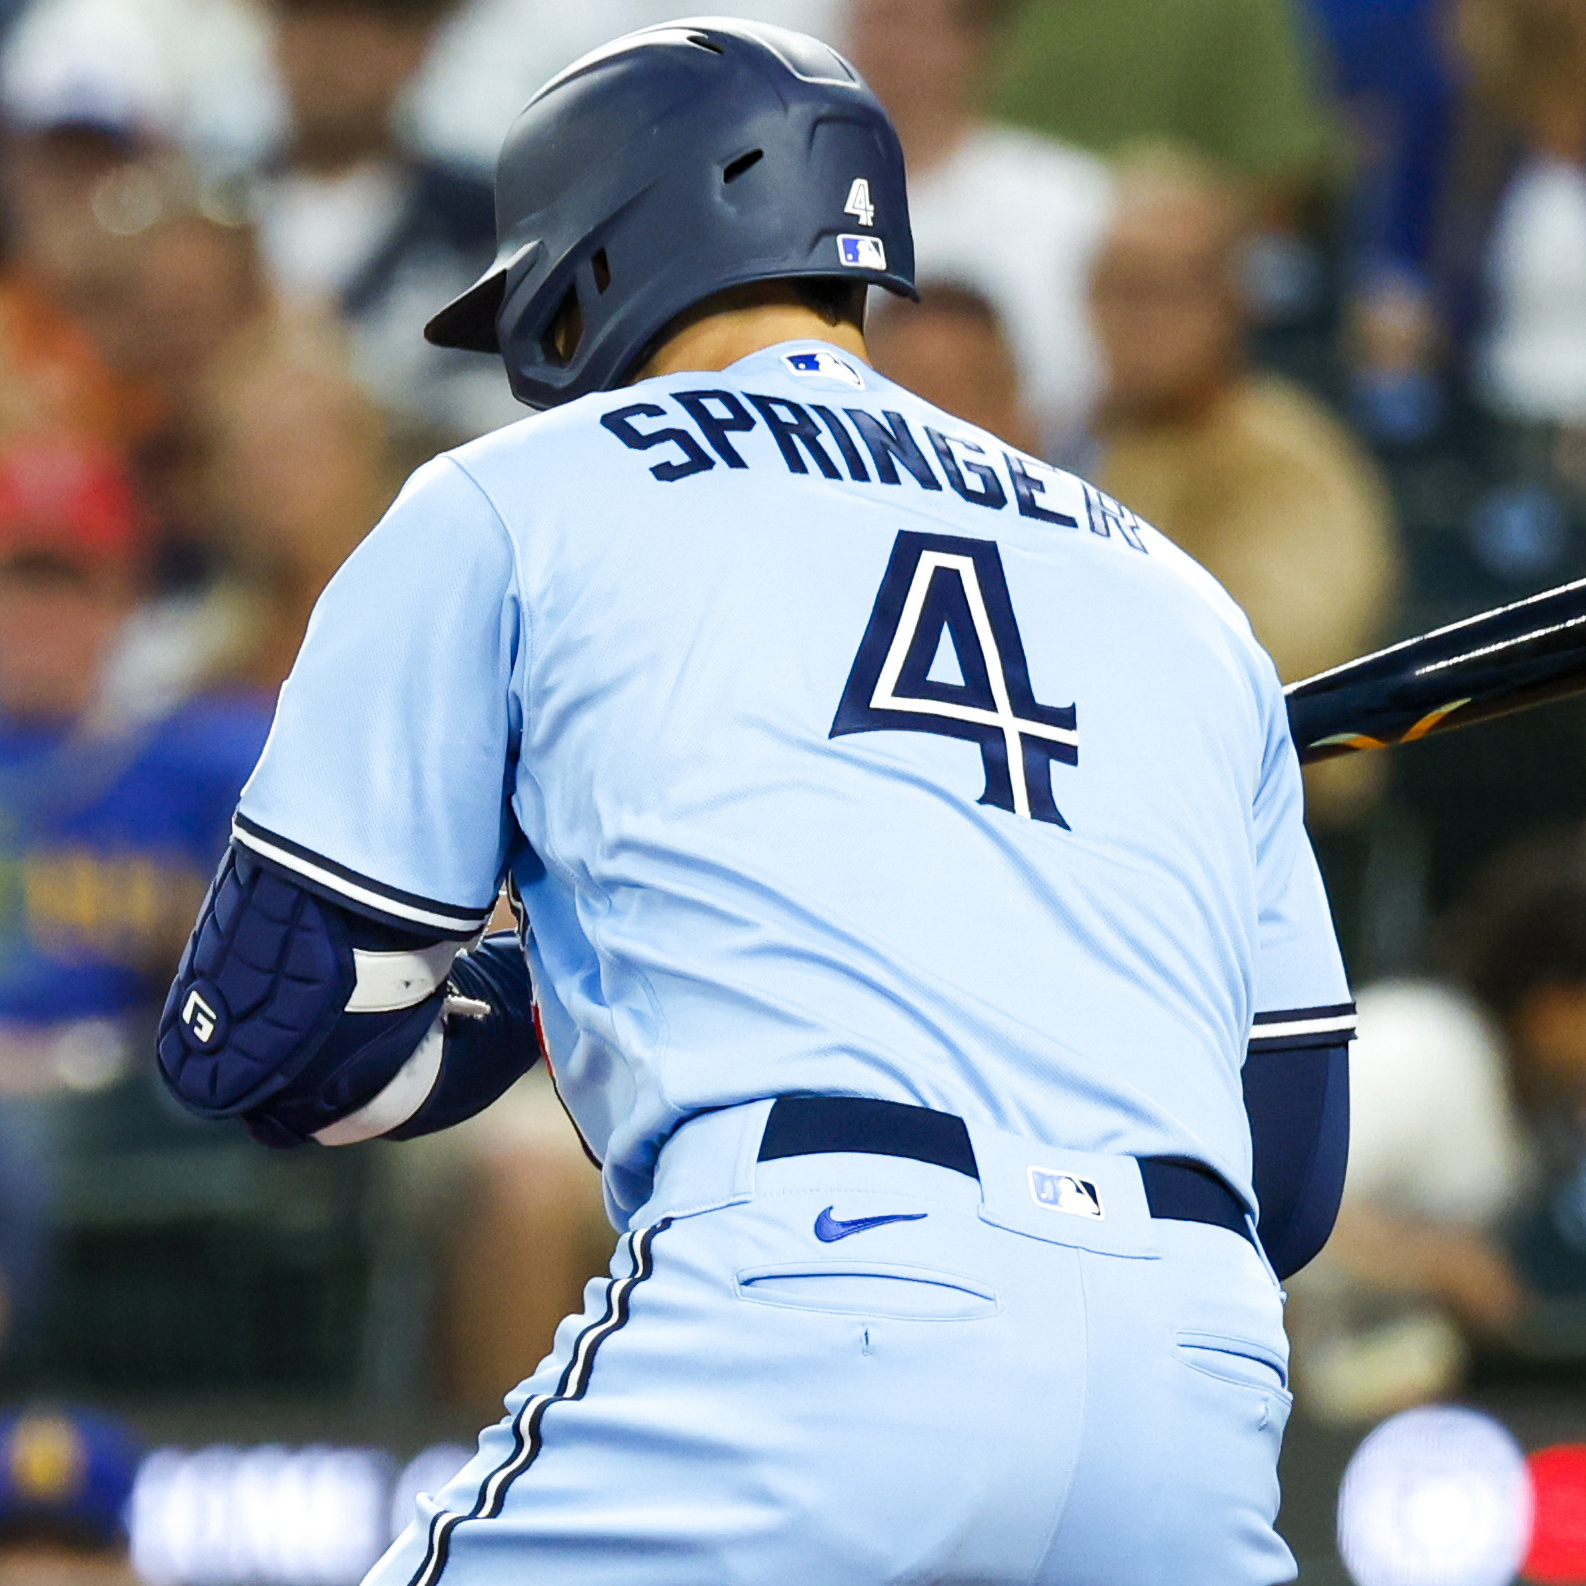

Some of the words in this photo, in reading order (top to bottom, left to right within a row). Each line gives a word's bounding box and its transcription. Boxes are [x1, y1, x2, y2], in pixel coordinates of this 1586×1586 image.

[843, 177, 875, 227] 4
[599, 388, 1149, 554] SPRINGER
[827, 528, 1079, 832] 4
